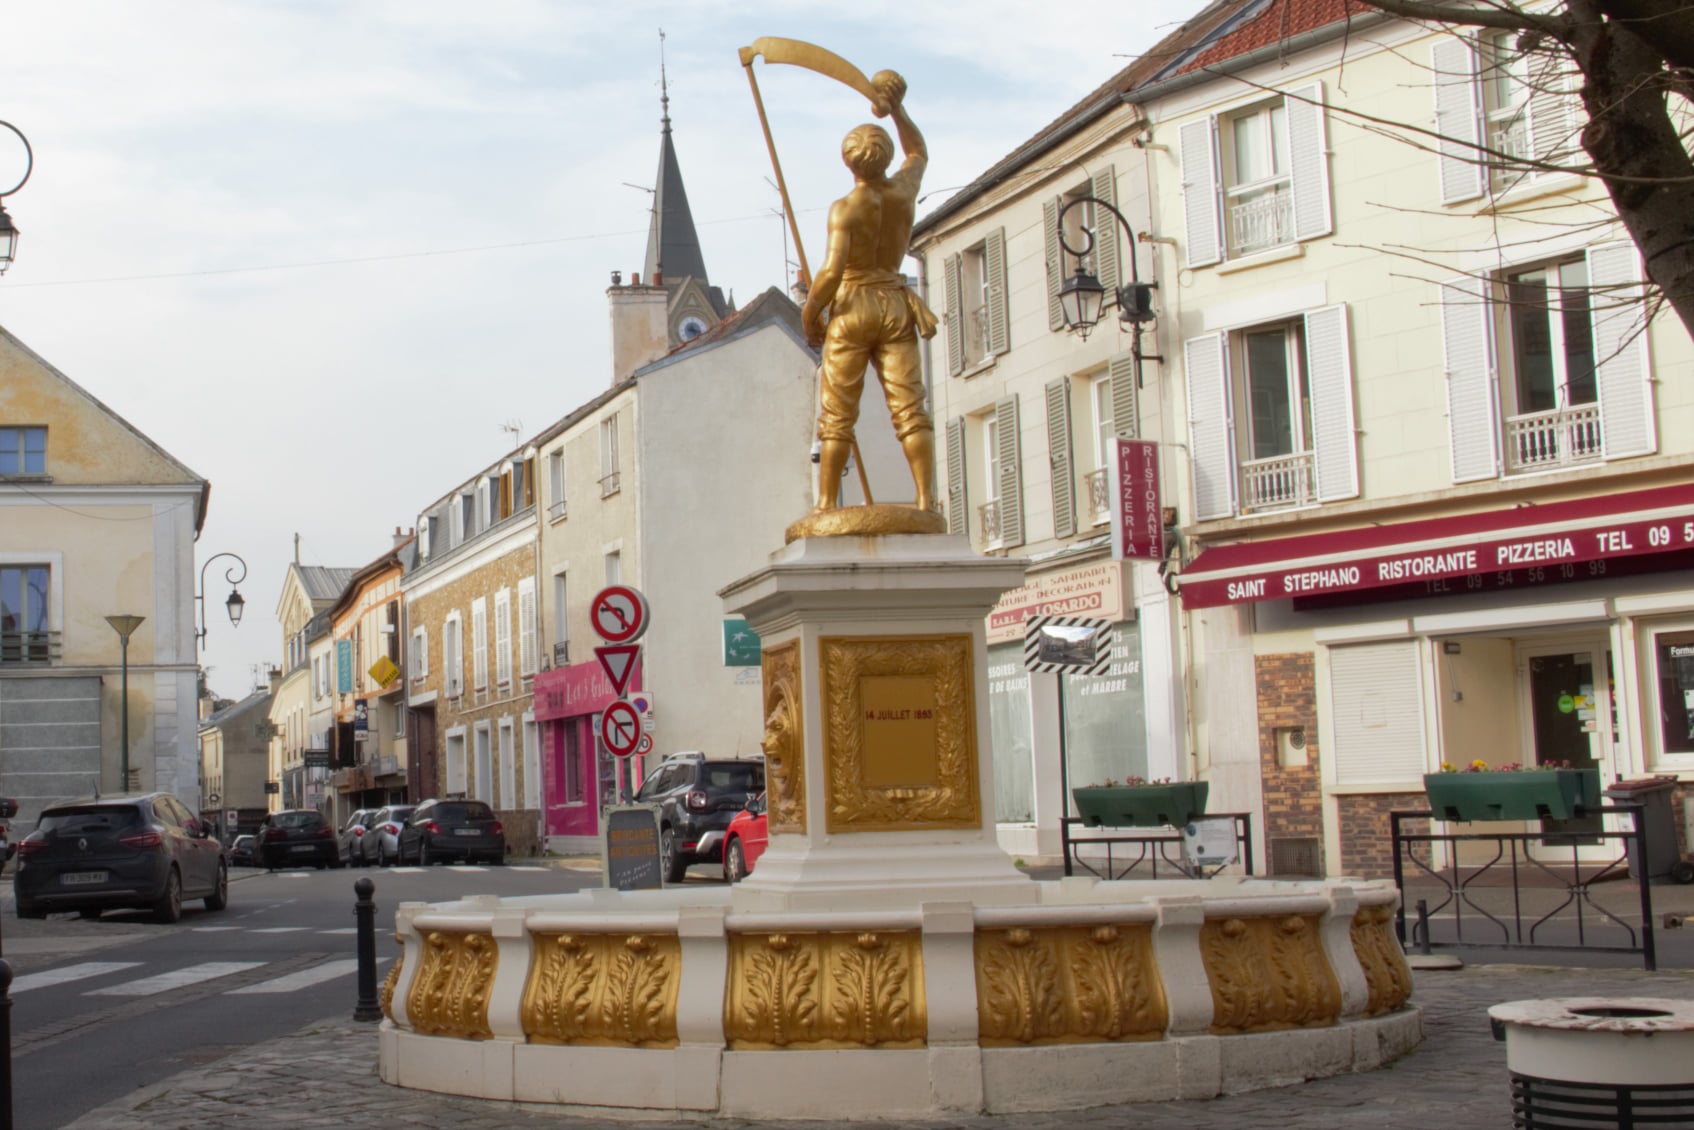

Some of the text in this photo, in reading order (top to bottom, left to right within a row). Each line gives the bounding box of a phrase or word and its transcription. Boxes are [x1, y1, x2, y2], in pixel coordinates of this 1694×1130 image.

[1122, 446, 1136, 554] PIZZERIA
[1142, 445, 1158, 557] RISTORANTE
[1228, 578, 1266, 600] SAINT
[1283, 566, 1360, 592] STEPHANO
[1378, 550, 1477, 581] RISTORANTE
[1496, 538, 1575, 565] PIZZERIA
[1596, 531, 1632, 553] TEL
[1648, 526, 1670, 546] 09
[1425, 560, 1606, 592] TEL 09 54 56 10 99
[1035, 594, 1100, 616] LOSARDO
[1092, 679, 1127, 695] MARBRE
[865, 710, 874, 720] 14
[877, 709, 910, 720] JUILLET
